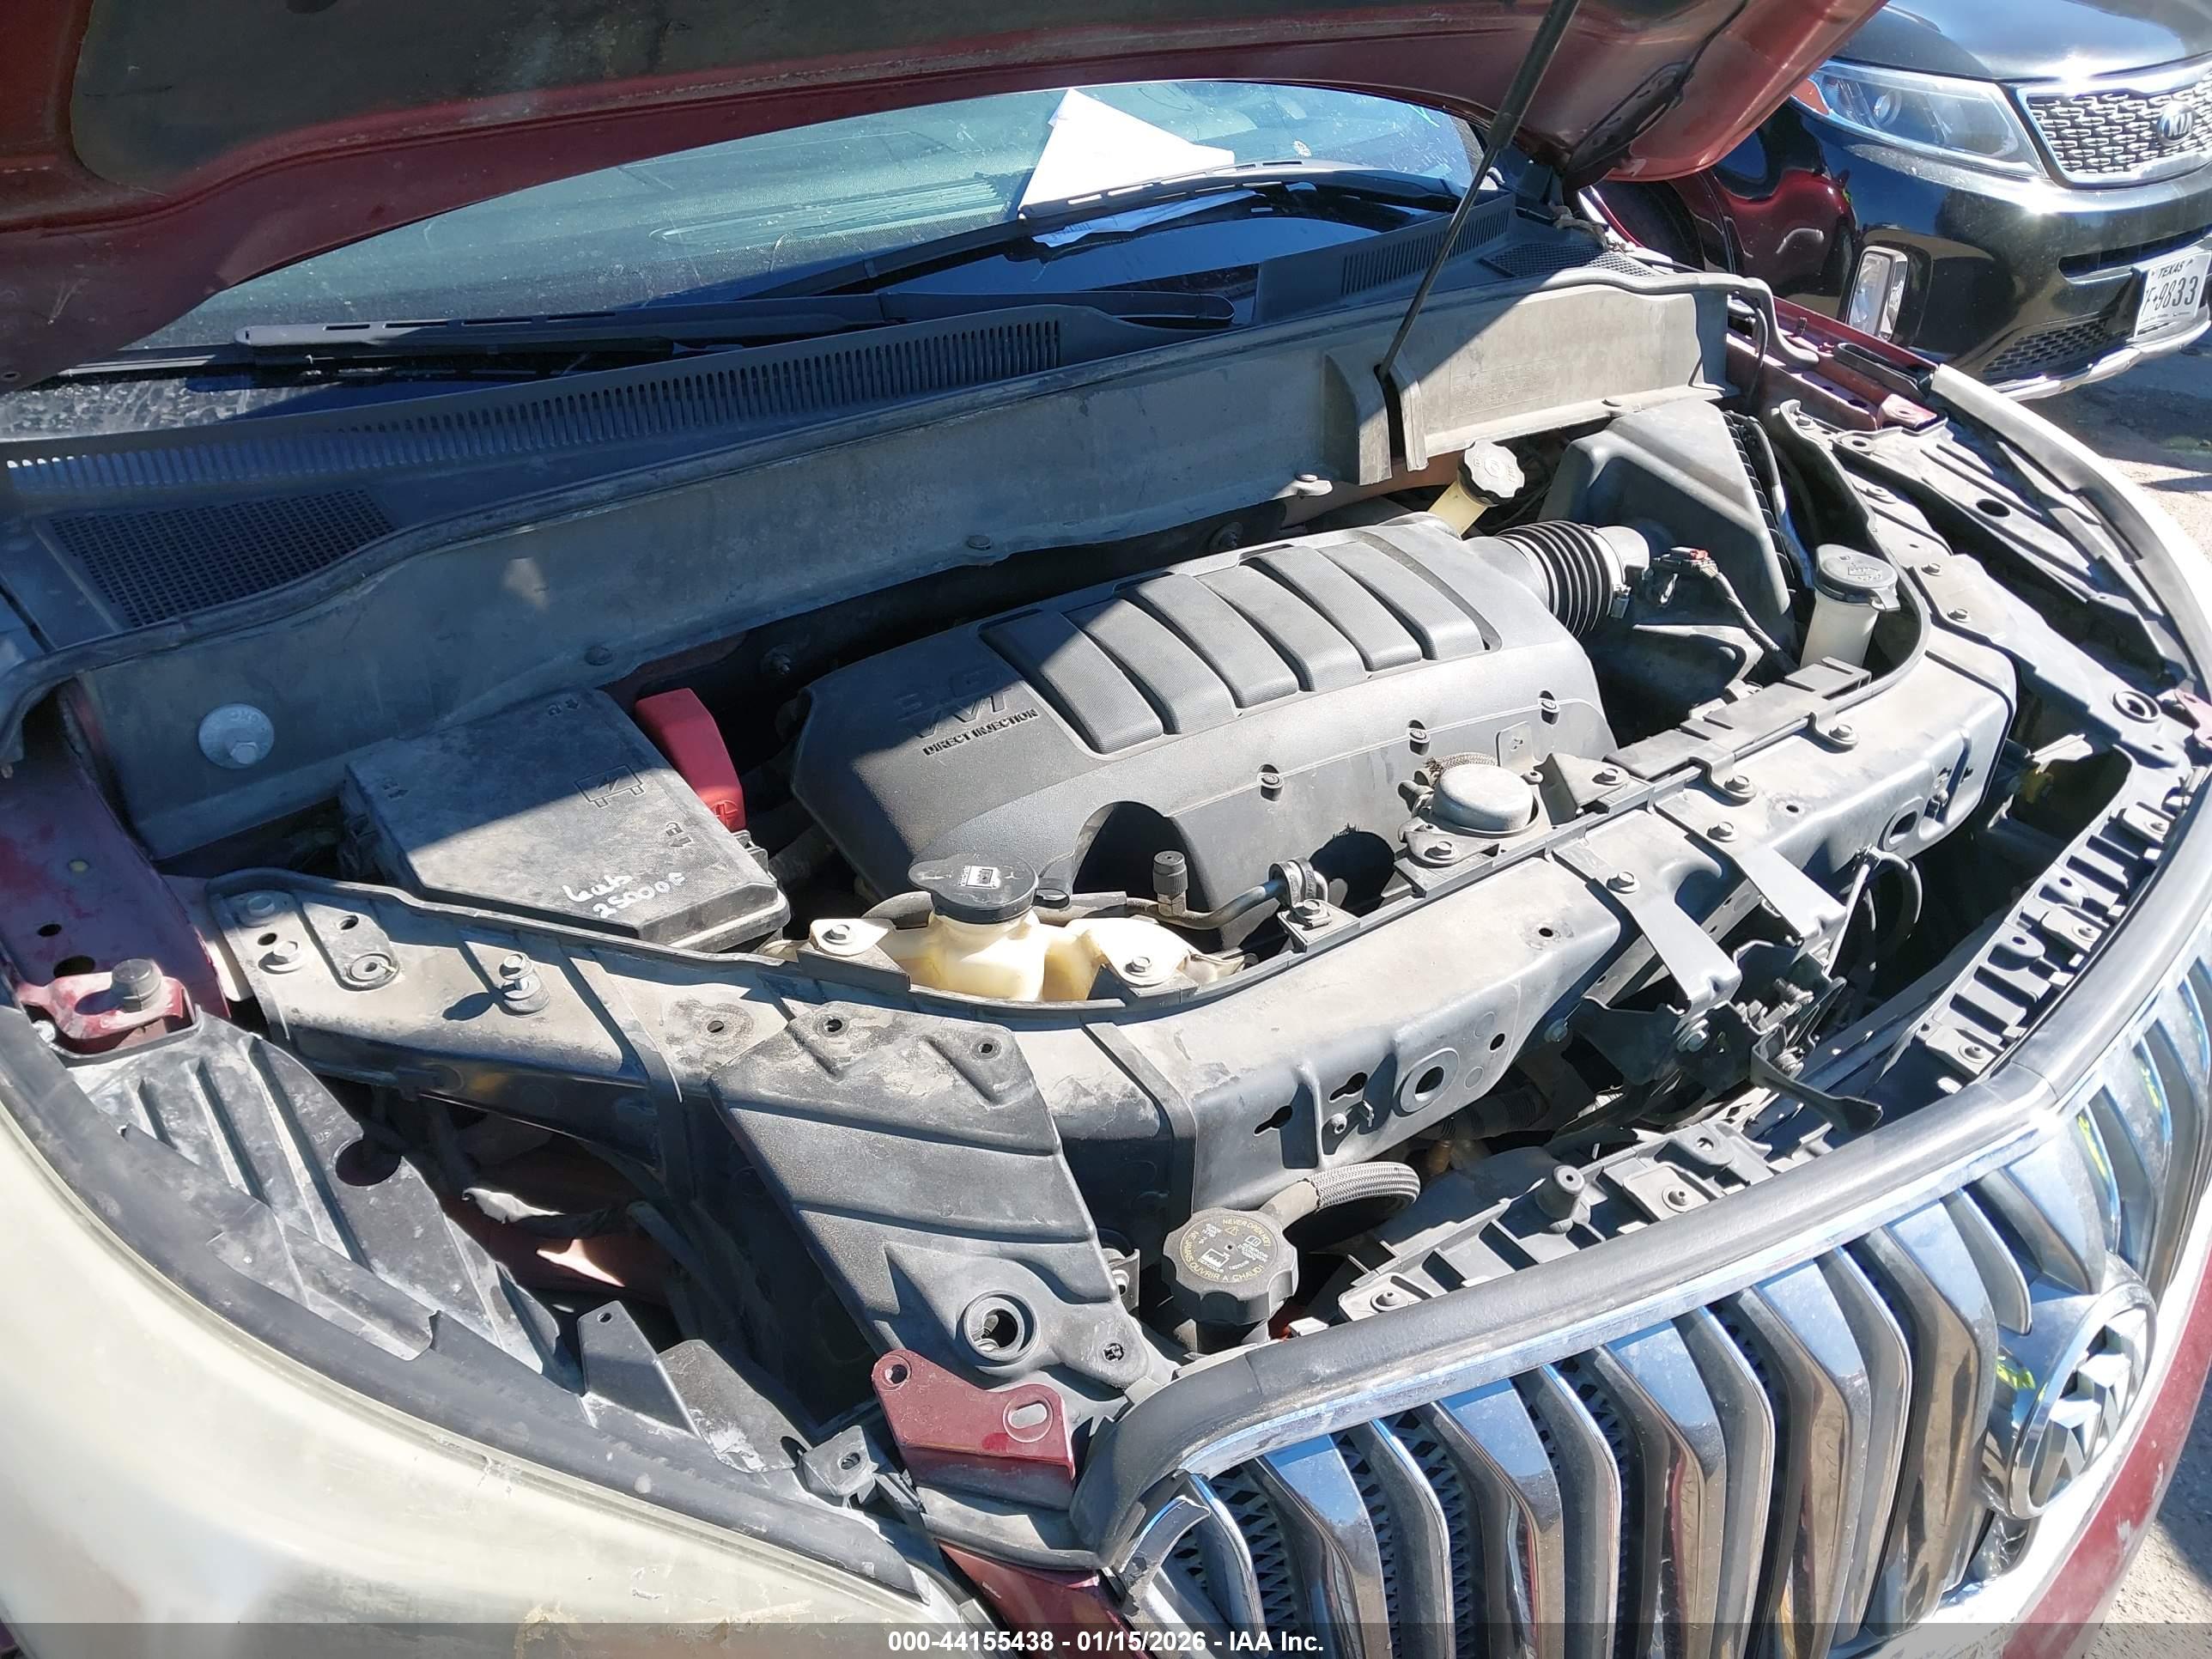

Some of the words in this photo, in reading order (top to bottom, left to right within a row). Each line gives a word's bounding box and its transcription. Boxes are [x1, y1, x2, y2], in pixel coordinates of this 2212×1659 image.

[2168, 112, 2192, 137] KIA
[2158, 260, 2185, 279] TEXAS
[922, 731, 971, 757] DIRECT
[971, 707, 1039, 738] INJECTION
[1222, 1218, 1247, 1228] NEVER
[1247, 1221, 1266, 1238] OPEN
[1189, 1261, 1220, 1281] OUVRIR
